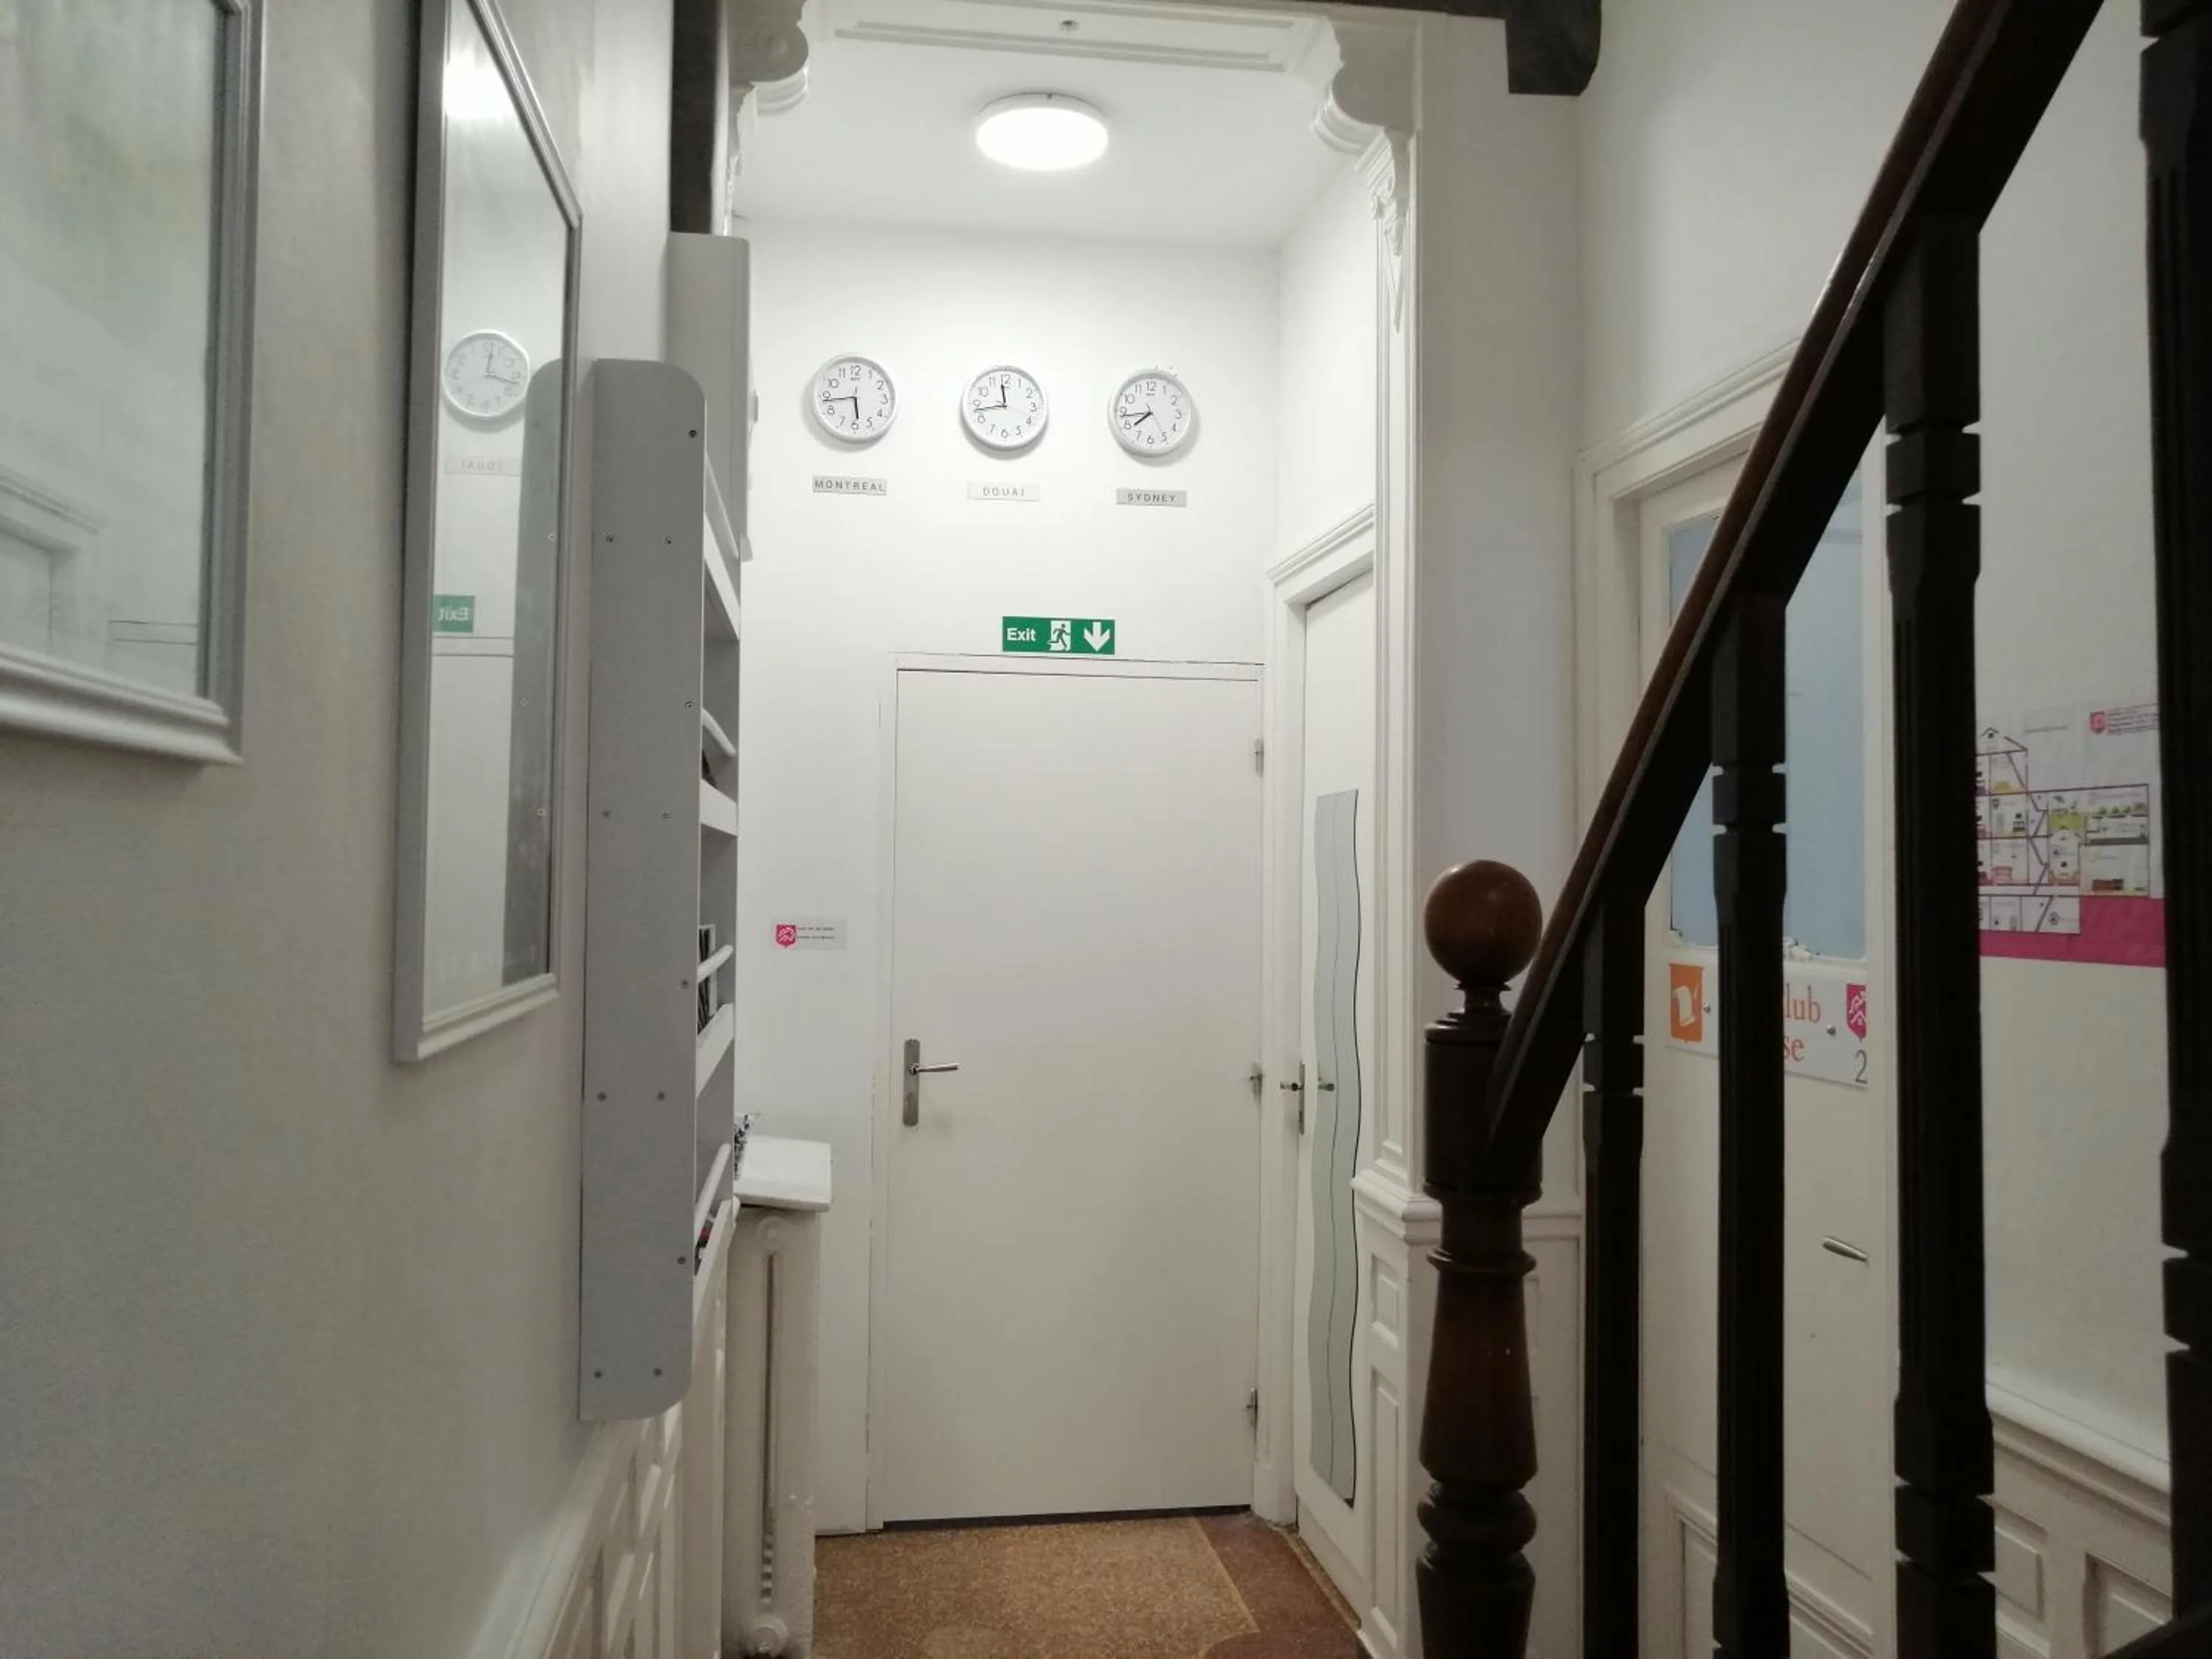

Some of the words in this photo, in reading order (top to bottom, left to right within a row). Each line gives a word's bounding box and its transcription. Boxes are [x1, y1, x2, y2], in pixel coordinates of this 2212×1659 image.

[838, 369, 846, 378] 11
[850, 366, 861, 376] 12
[827, 378, 838, 389] 10
[989, 377, 995, 386] 11
[1001, 374, 1011, 384] 12
[877, 380, 884, 390] 2
[1135, 384, 1141, 394] 11
[1146, 381, 1156, 391] 12
[978, 387, 989, 397] 10
[1026, 388, 1033, 398] 2
[881, 394, 888, 405] 3
[1124, 394, 1135, 404] 10
[1171, 394, 1178, 405] 2
[827, 406, 835, 415] 8
[1030, 403, 1037, 412] 3
[978, 414, 986, 423] 8
[1175, 409, 1182, 419] 3
[840, 416, 846, 425] 7
[851, 420, 859, 430] 6
[866, 417, 872, 428] 5
[1124, 420, 1132, 430] 8
[990, 425, 995, 434] 7
[1001, 429, 1009, 438] 6
[1016, 425, 1021, 435] 5
[1136, 431, 1141, 440] 7
[1147, 436, 1155, 444] 6
[1161, 432, 1167, 442] 5
[814, 480, 885, 491] MONTREAL
[983, 487, 1024, 496] DOUAI
[1127, 493, 1176, 502] SYDNEY
[1006, 627, 1036, 641] Exit
[1784, 983, 1821, 1023] lub
[1855, 1049, 1868, 1084] 2
